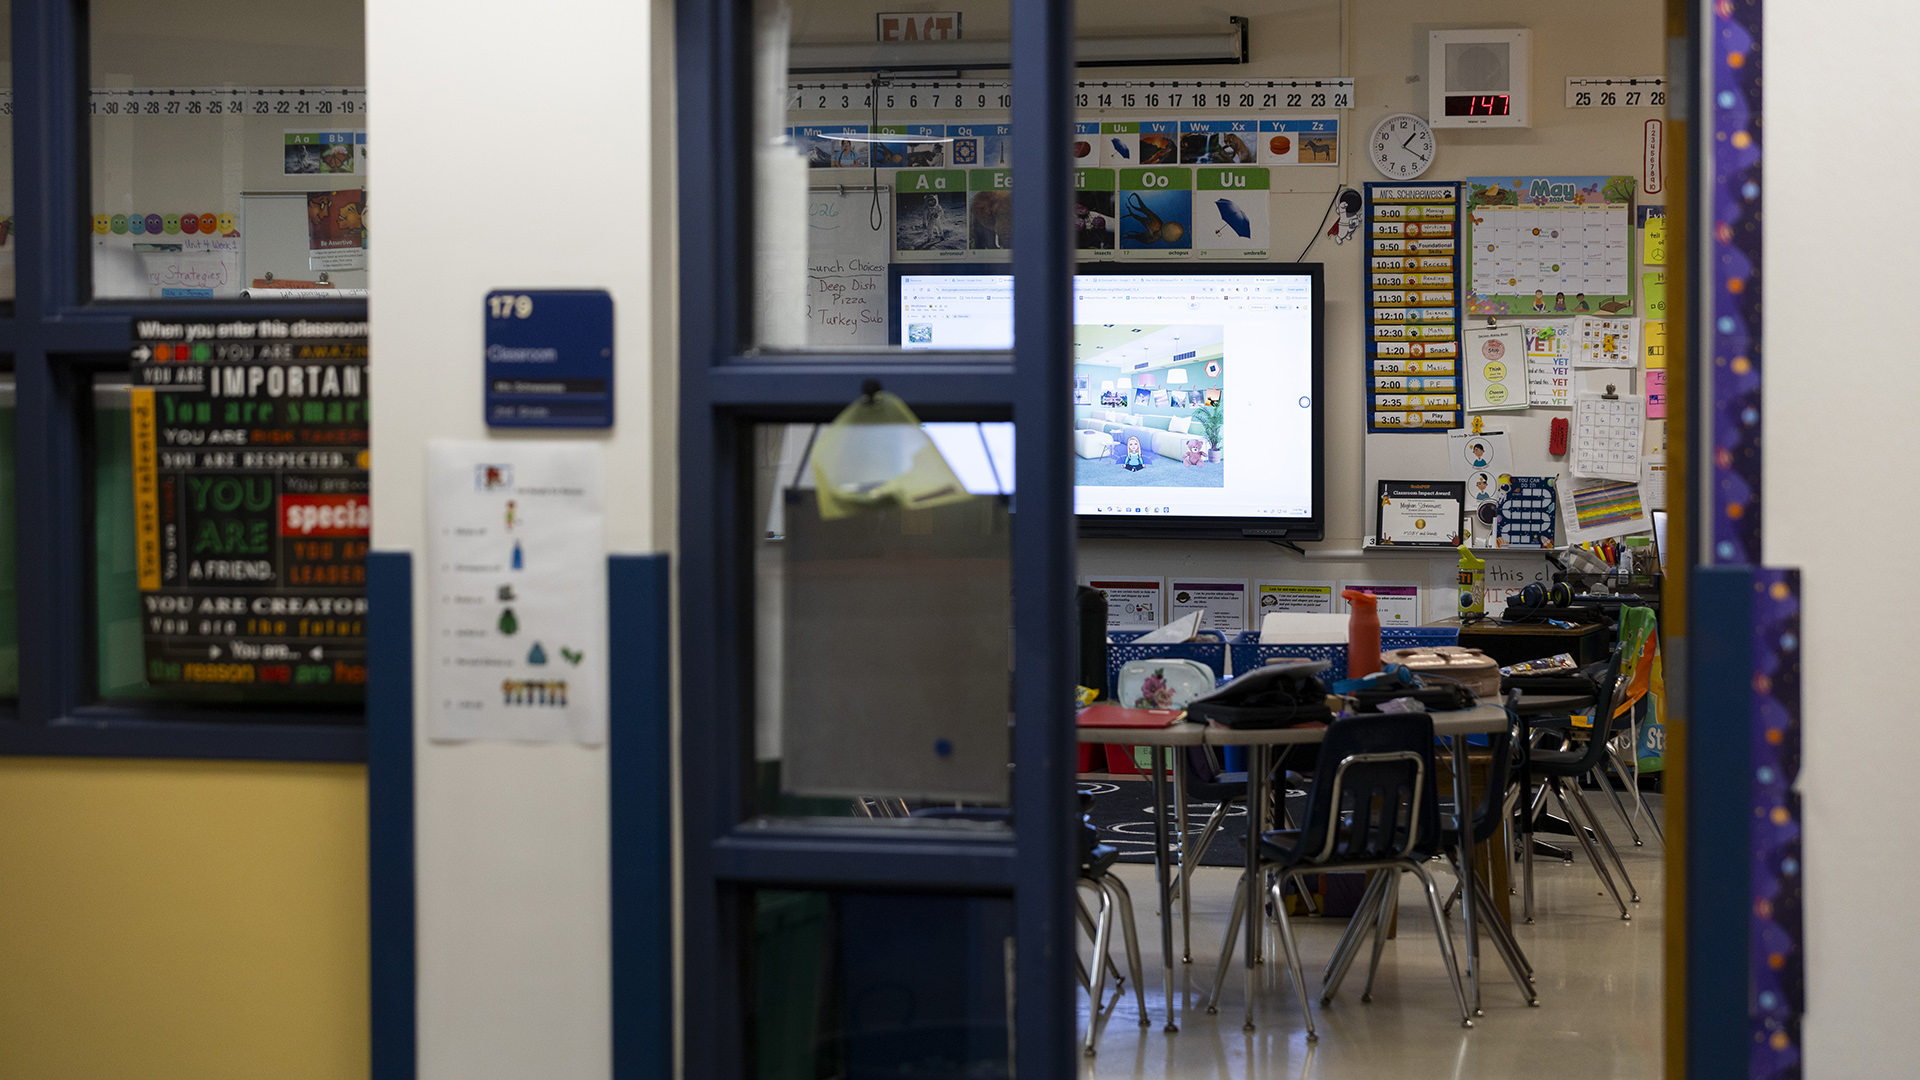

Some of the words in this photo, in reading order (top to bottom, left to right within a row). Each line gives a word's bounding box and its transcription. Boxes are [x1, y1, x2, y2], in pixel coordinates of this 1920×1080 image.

[797, 96, 802, 108] 1
[819, 96, 826, 108] 2
[842, 96, 849, 108] 3
[864, 96, 871, 108] 4
[887, 96, 894, 108] 5
[910, 96, 917, 108] 6
[933, 96, 939, 108] 7
[955, 95, 962, 108] 8
[978, 95, 985, 108] 9
[998, 95, 1011, 107] 10
[1075, 94, 1088, 106] 13
[1098, 94, 1111, 106] 14
[1122, 94, 1135, 106] 15
[1145, 94, 1158, 106] 16
[1169, 94, 1182, 106] 17
[1193, 94, 1206, 106] 18
[1216, 94, 1230, 106] 19
[1240, 94, 1254, 106] 20
[1264, 94, 1277, 106] 21
[1287, 94, 1301, 106] 22
[1311, 94, 1325, 106] 23
[1335, 94, 1347, 106] 24
[1470, 95, 1510, 115] 147
[1576, 93, 1590, 105] 25
[1601, 93, 1615, 105] 26
[1626, 93, 1640, 105] 27
[1651, 93, 1665, 105] 28
[102, 102, 118, 113] -30
[123, 102, 139, 113] -29
[144, 102, 159, 113] -28
[164, 102, 180, 113] -27
[185, 102, 201, 113] -26
[206, 102, 222, 113] -25
[227, 102, 242, 113] -24
[253, 102, 268, 113] -23
[274, 102, 289, 113] -22
[295, 102, 309, 113] -21
[315, 102, 332, 113] -20
[337, 102, 354, 113] -19
[1190, 123, 1209, 131] Ww
[1232, 123, 1245, 131] Xx
[1273, 123, 1286, 132] Yy
[1312, 122, 1324, 130] Zz
[1400, 121, 1407, 129] 12
[804, 128, 822, 136] Mm
[843, 127, 856, 135] Nn
[882, 128, 895, 136] Oo
[920, 127, 932, 137] Pp
[958, 127, 972, 137] Qq
[295, 134, 301, 143] A
[329, 134, 336, 143] B
[337, 134, 343, 143] b
[1378, 143, 1384, 151] 9
[1382, 154, 1387, 162] 8
[916, 175, 930, 189] A
[935, 177, 946, 189] a
[994, 173, 1013, 188] Ee
[1142, 172, 1169, 187] Oo
[1220, 172, 1246, 187] Uu
[1531, 179, 1575, 201] May
[809, 203, 839, 217] 026
[1379, 226, 1398, 234] 9:15
[185, 240, 200, 249] Unit
[202, 240, 209, 249] 4
[212, 240, 231, 249] Week
[809, 259, 844, 272] Lunch
[820, 280, 846, 298] Deep
[852, 278, 876, 290] Dish
[832, 294, 867, 305] Pizza
[1378, 295, 1402, 303] 11:30
[488, 295, 533, 319] 179
[818, 309, 858, 334] Turkey
[861, 309, 883, 324] Sub
[137, 321, 184, 339] When
[185, 323, 215, 342] you
[258, 320, 288, 338] this
[1526, 336, 1561, 353] YET!
[1386, 347, 1404, 355] 1:20
[1553, 367, 1568, 375] YET
[211, 366, 368, 397] IMPORTAN
[1381, 381, 1400, 389] 2:00
[1381, 416, 1400, 424] 3:05
[188, 477, 273, 511] YOU
[287, 500, 369, 534] specia
[197, 519, 269, 553] ARE
[189, 560, 203, 580] A
[1490, 565, 1524, 581] this
[145, 597, 193, 614] YOU
[198, 597, 248, 614] ARE
[252, 597, 368, 614] CREATOR
